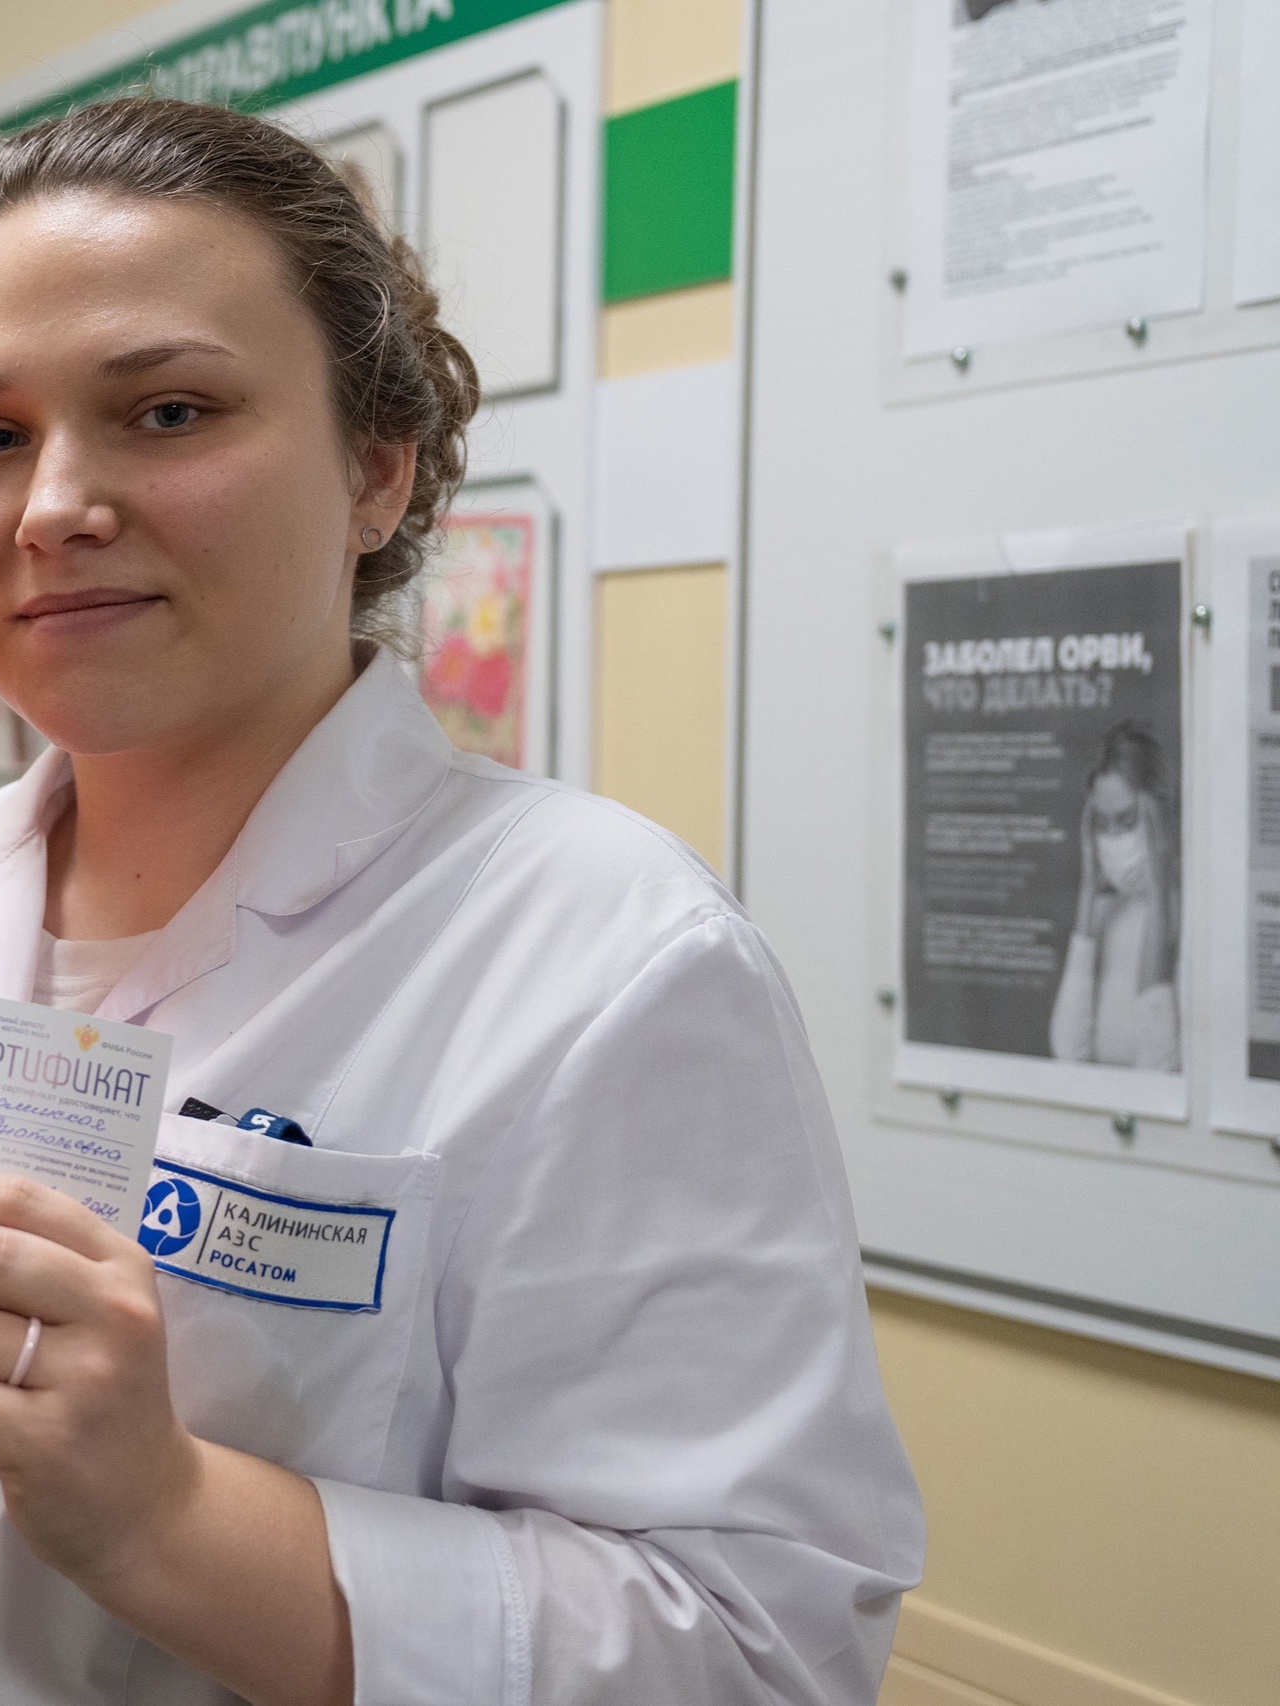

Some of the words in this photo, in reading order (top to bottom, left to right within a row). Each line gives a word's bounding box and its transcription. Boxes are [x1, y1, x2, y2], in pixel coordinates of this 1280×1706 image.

[923, 636, 1054, 676] ЗАБОЛЕЛ
[1058, 632, 1153, 675] ОРВИ,
[924, 677, 978, 711] ЧТО
[982, 673, 1113, 715] ДЕЛАТЬ?
[223, 1202, 368, 1245] КАЛИНИНСКАЯ
[209, 1249, 297, 1282] РОСАТОМ
